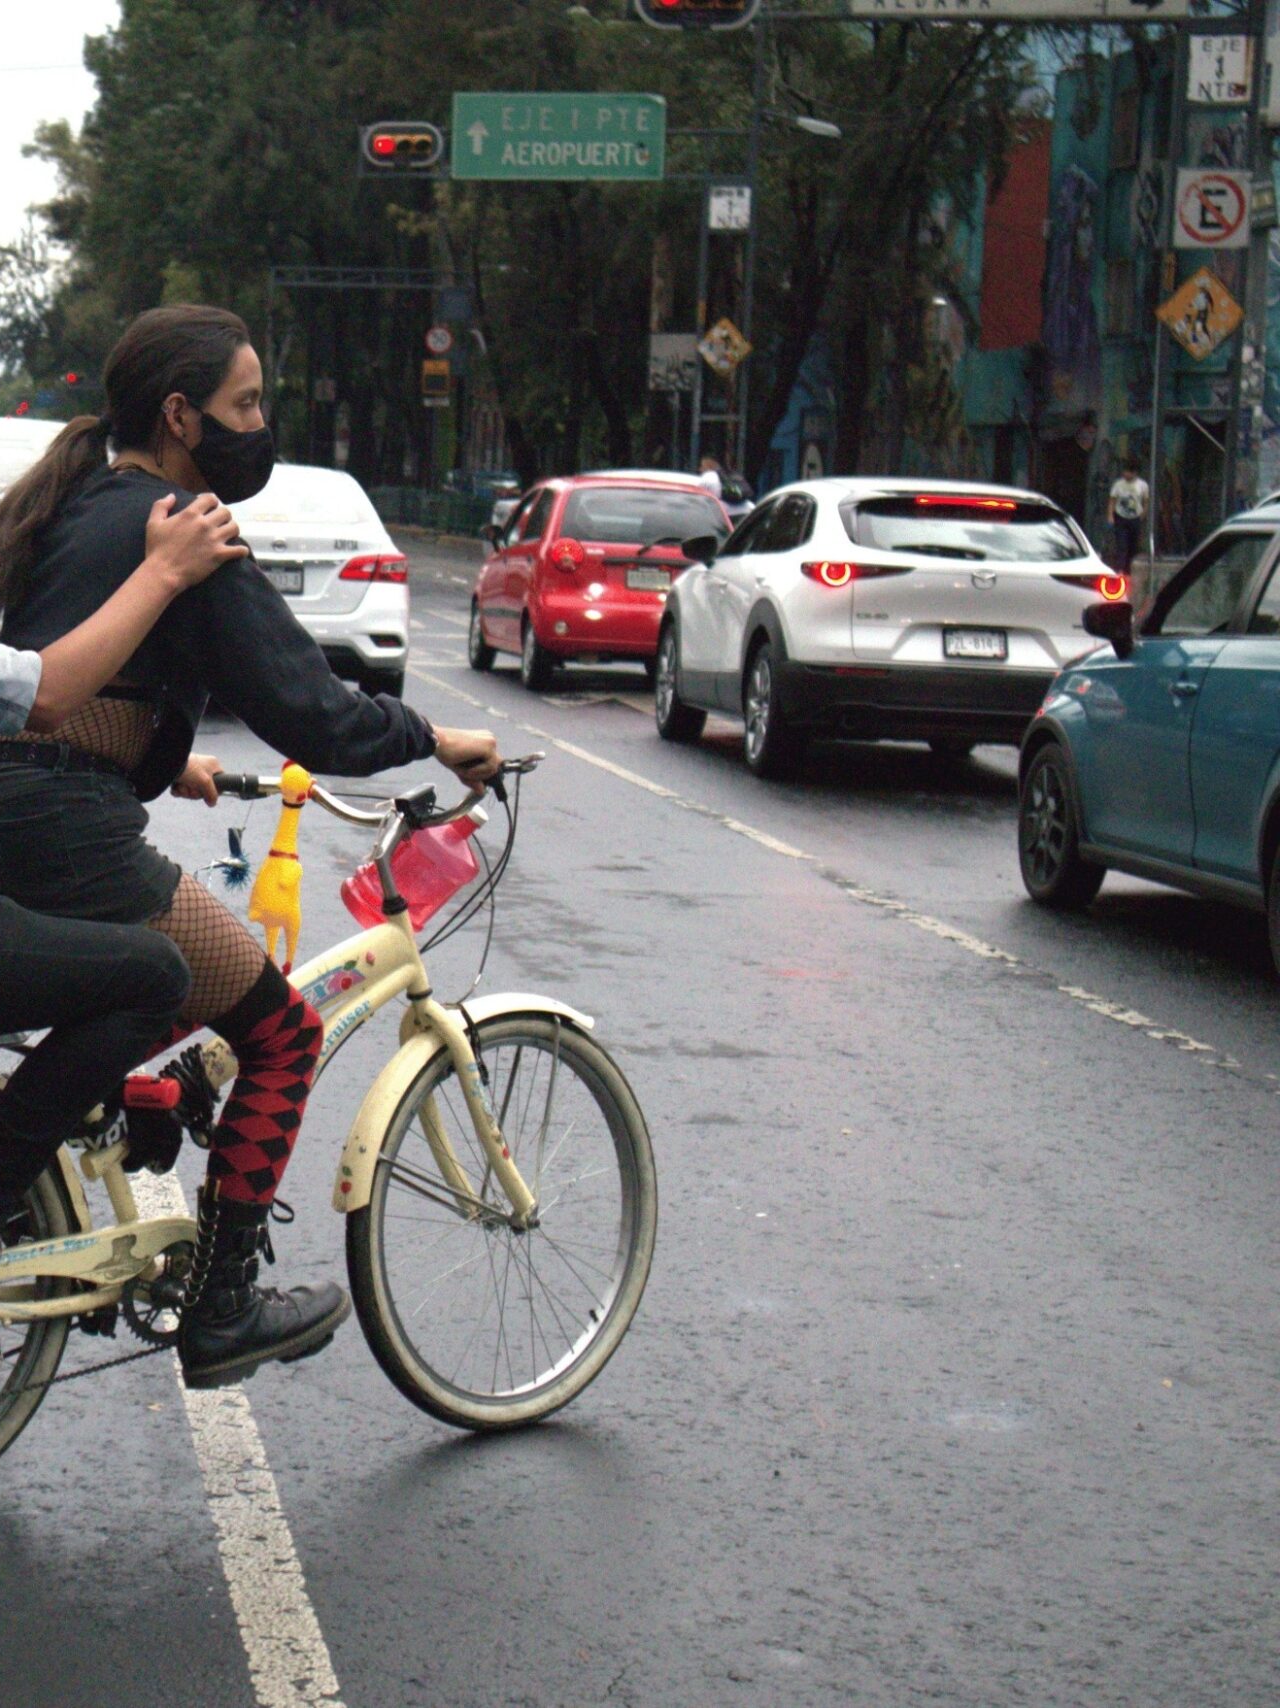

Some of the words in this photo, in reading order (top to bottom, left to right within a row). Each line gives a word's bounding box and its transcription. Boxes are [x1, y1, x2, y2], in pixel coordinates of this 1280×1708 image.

[1202, 39, 1241, 52] EJE
[502, 107, 554, 132] EJE
[596, 107, 651, 132] PTE
